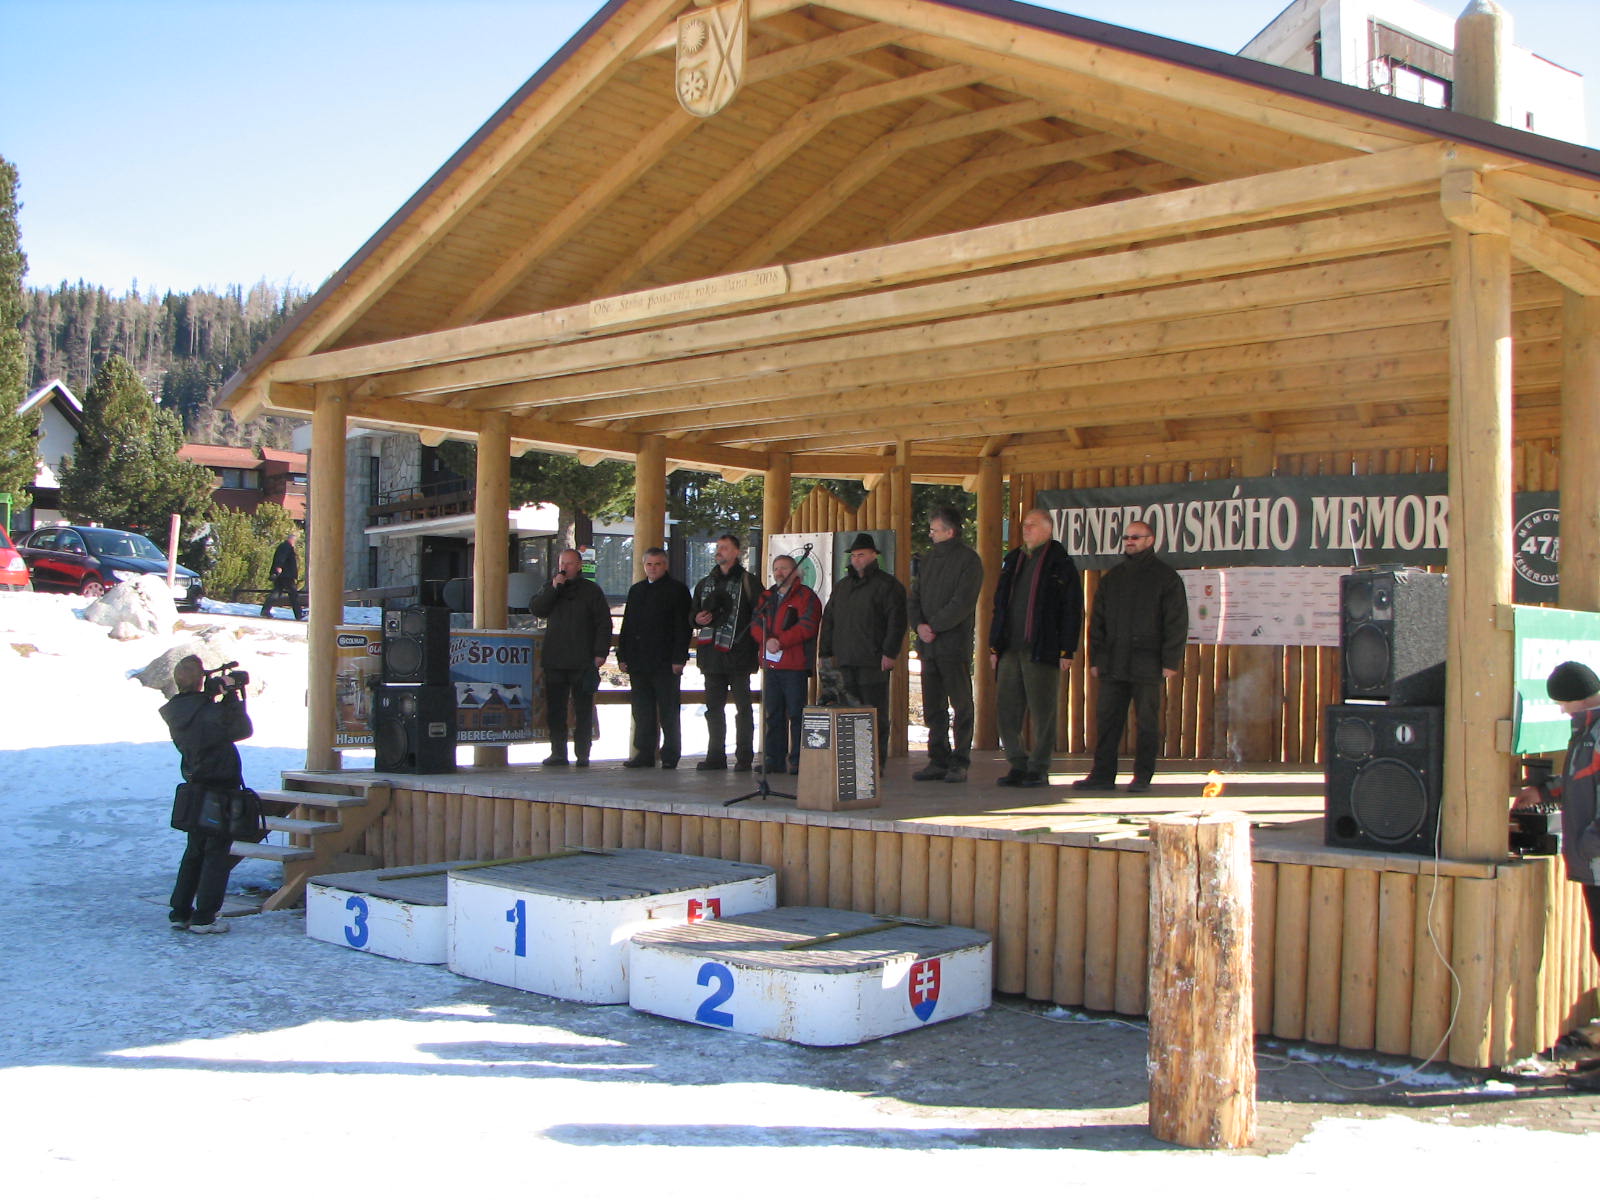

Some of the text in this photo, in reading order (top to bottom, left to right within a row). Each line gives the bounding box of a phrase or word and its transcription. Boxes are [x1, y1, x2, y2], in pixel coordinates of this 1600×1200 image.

[1048, 484, 1449, 556] VENEROVSKÉHO MEMOR
[1518, 512, 1560, 538] MEMOR
[468, 640, 531, 664] ŠPORT
[344, 895, 369, 949] 3
[506, 899, 526, 957] 1
[696, 961, 735, 1027] 2
